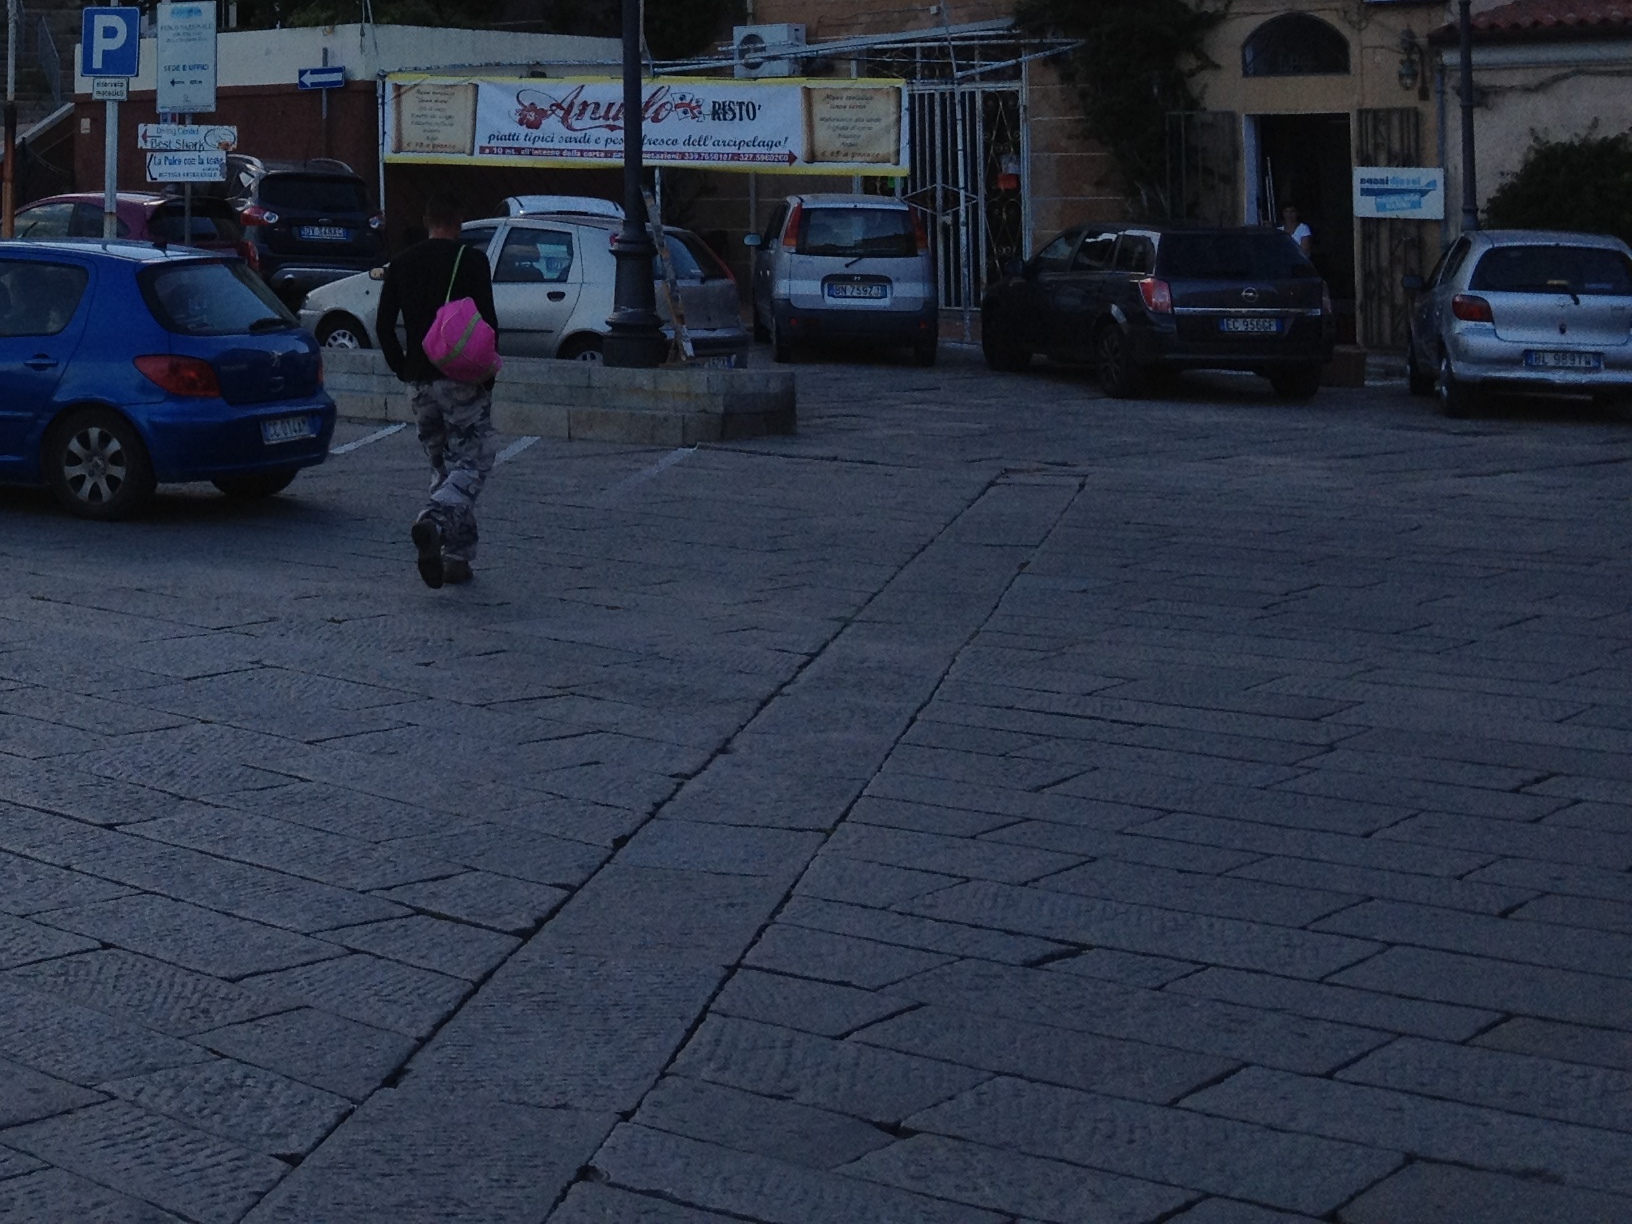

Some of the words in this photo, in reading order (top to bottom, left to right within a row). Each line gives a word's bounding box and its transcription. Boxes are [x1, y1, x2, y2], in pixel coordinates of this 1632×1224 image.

[92, 14, 128, 69] P
[487, 131, 520, 144] piatti
[523, 131, 555, 145] tipici
